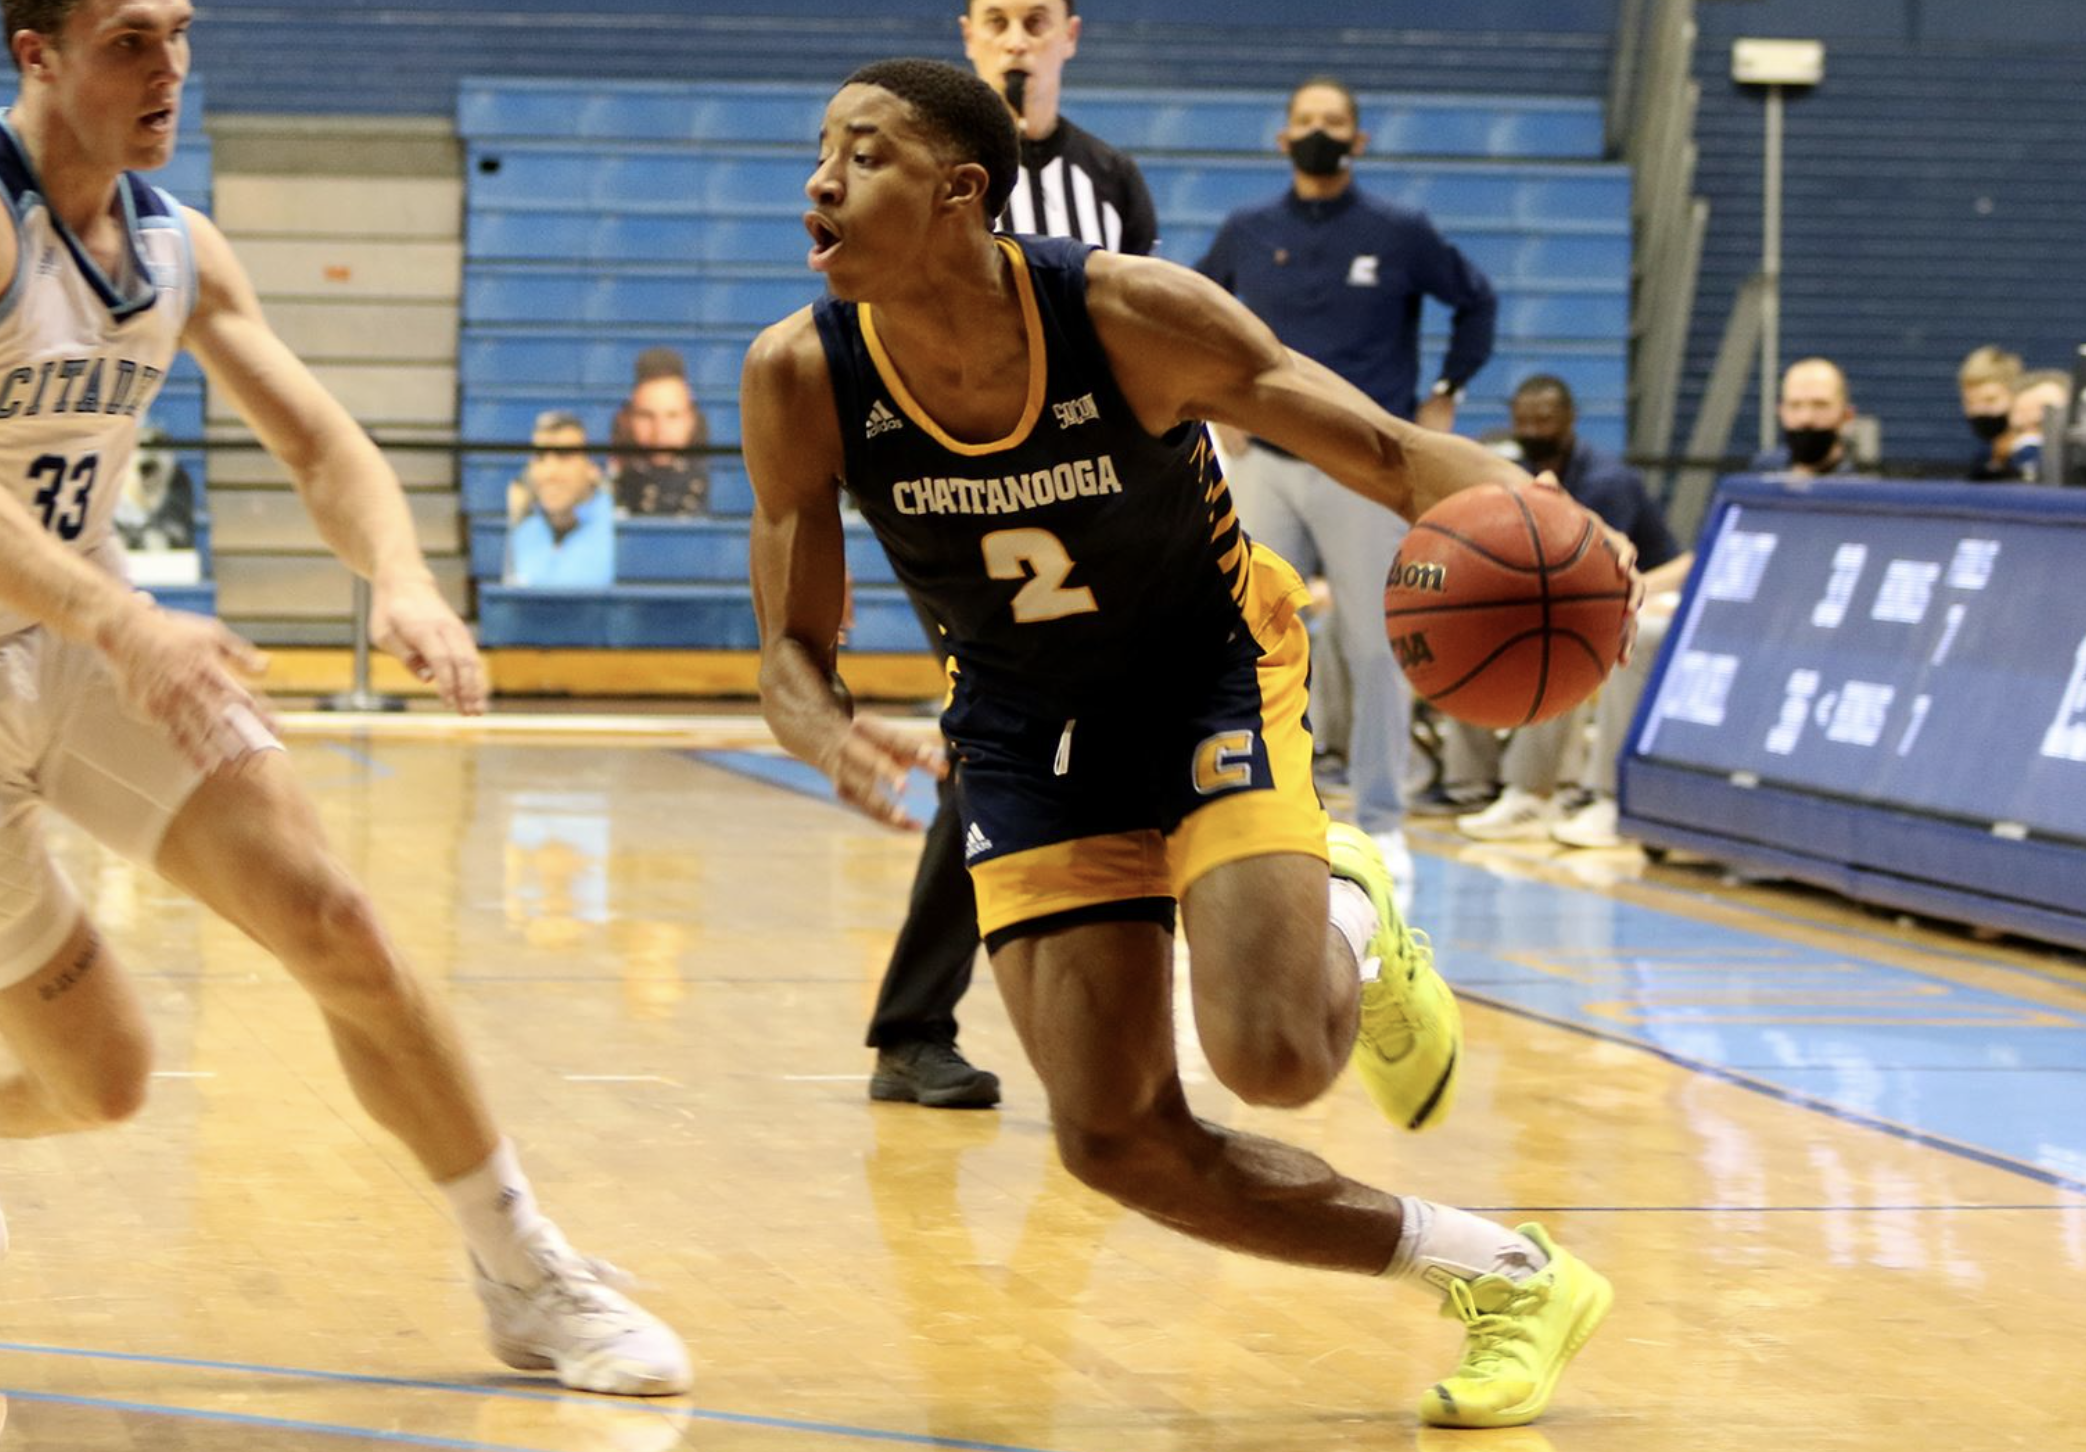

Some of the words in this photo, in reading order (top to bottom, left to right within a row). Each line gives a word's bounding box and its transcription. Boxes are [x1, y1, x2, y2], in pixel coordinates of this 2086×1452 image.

[27, 453, 98, 541] 33
[892, 454, 1123, 515] CHATTANOOGA
[980, 526, 1100, 624] 2
[1191, 729, 1254, 795] C
